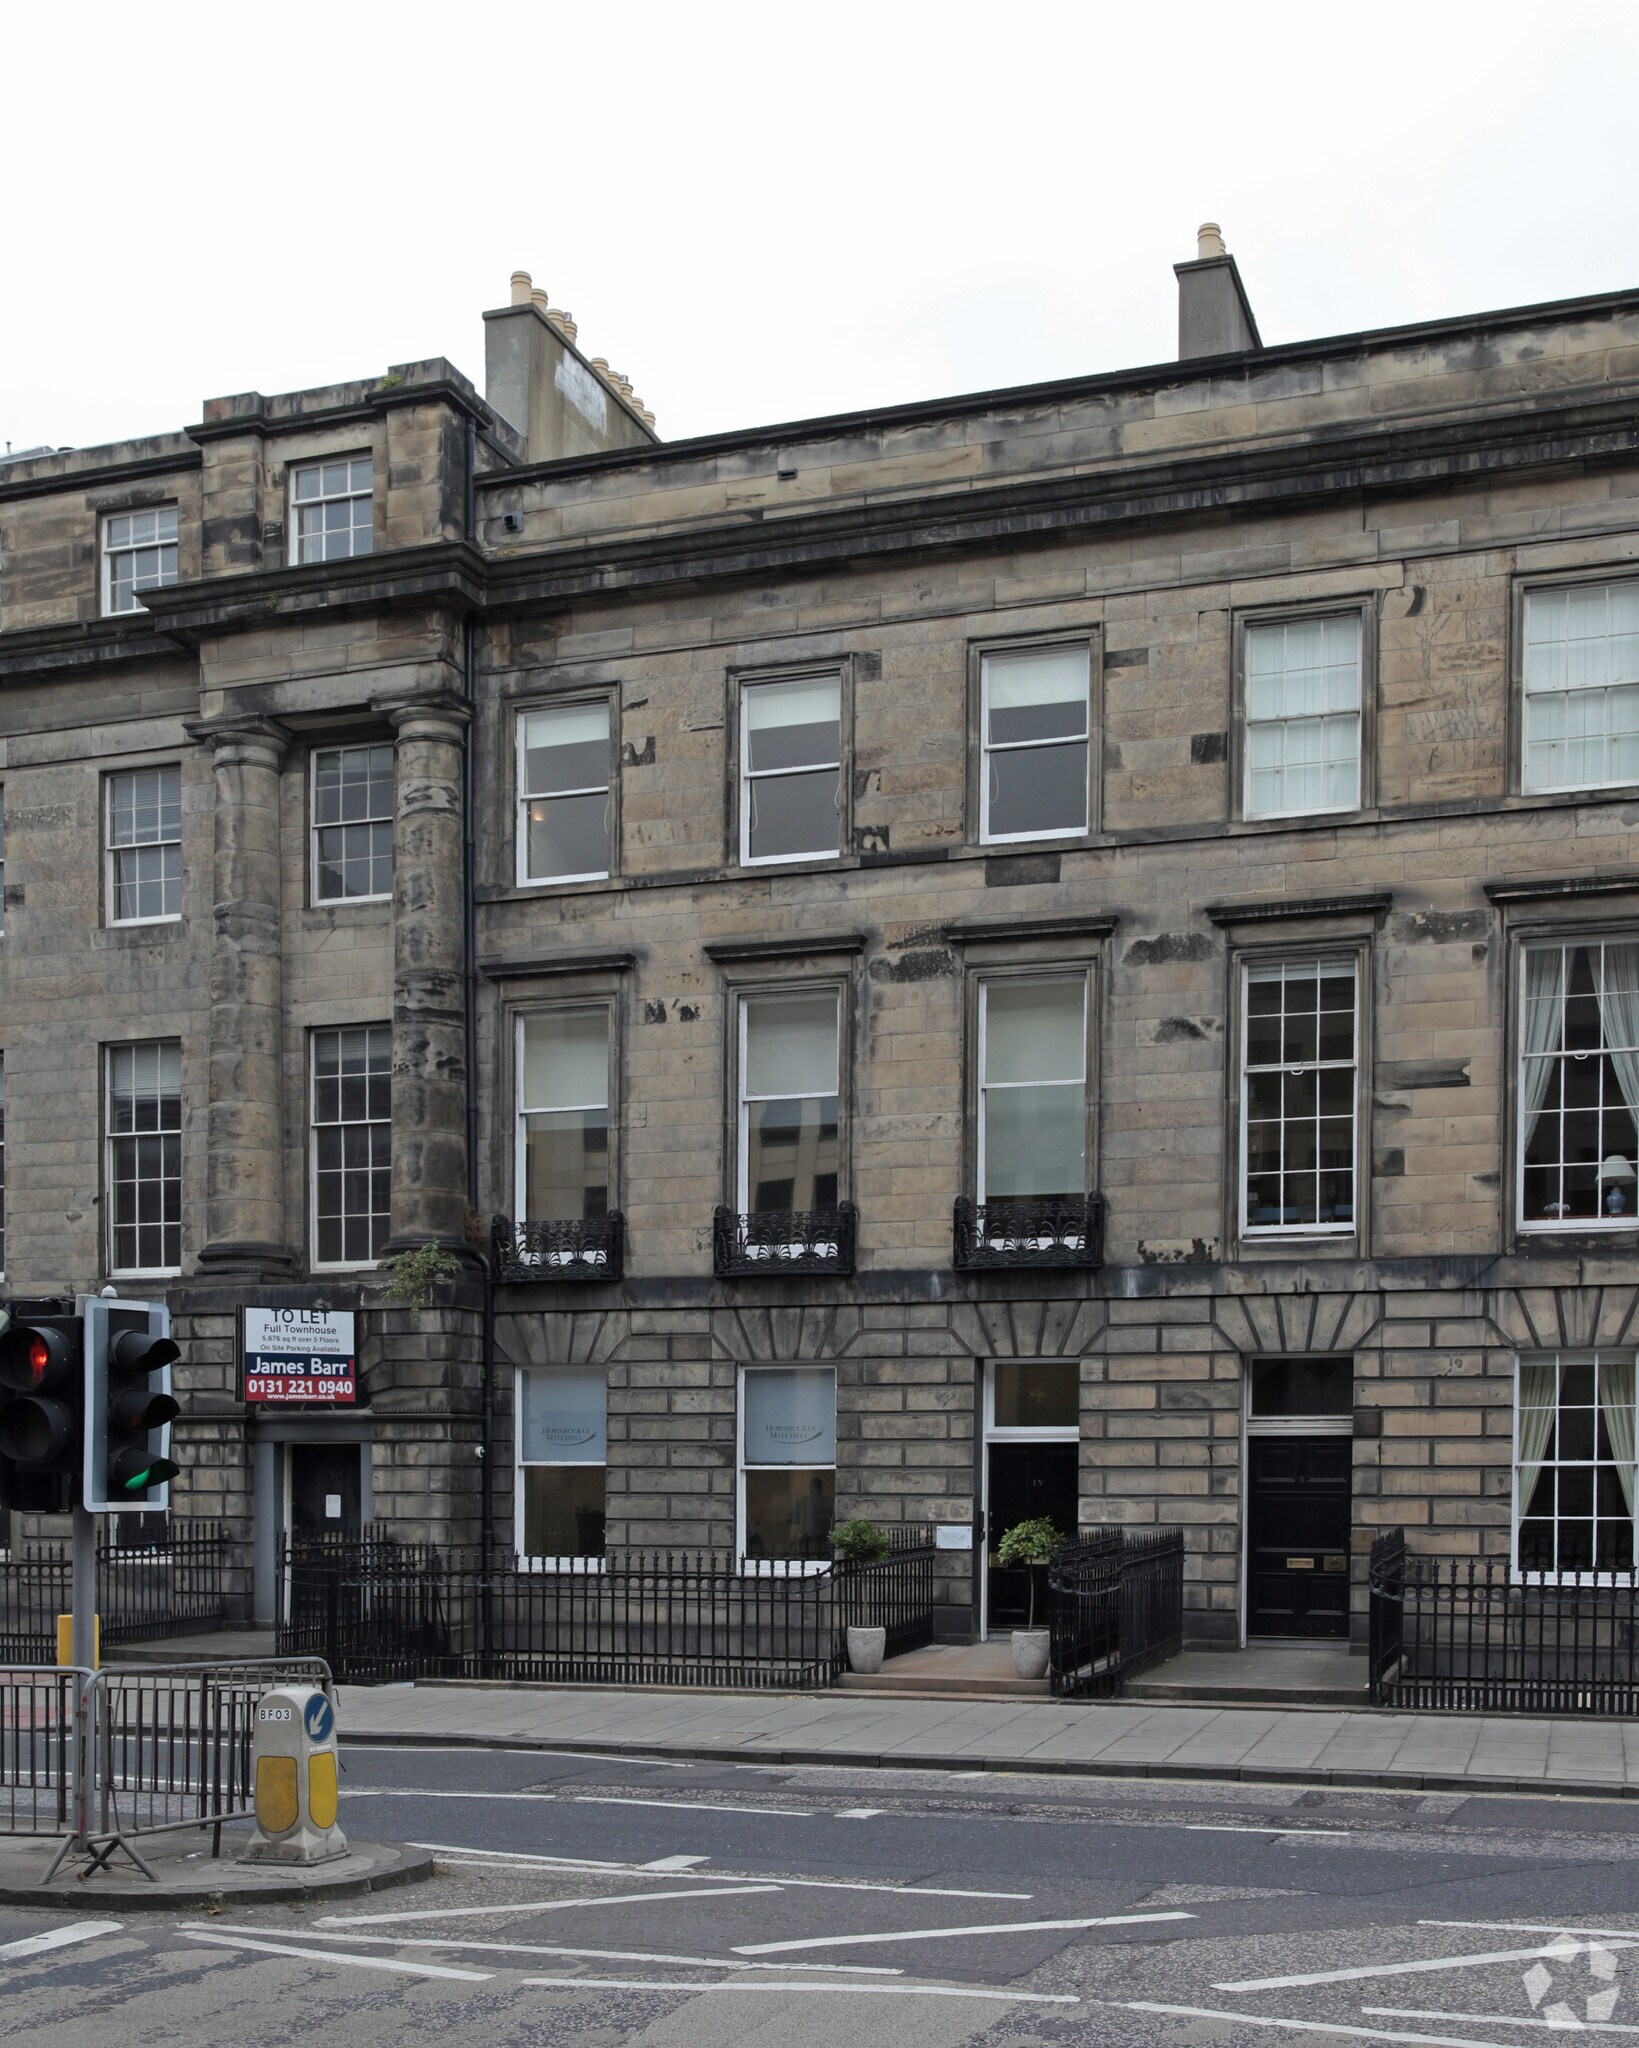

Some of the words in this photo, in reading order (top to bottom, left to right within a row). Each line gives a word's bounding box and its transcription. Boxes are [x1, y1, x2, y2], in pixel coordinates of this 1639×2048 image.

[271, 1309, 294, 1323] TO
[301, 1309, 330, 1324] LET
[264, 1324, 281, 1333] Full
[284, 1325, 337, 1335] Townhouse
[286, 1345, 311, 1353] Parking
[250, 1356, 305, 1375] James
[311, 1358, 347, 1375] Barr
[248, 1379, 283, 1393] 0131
[288, 1380, 313, 1393] 221
[318, 1380, 353, 1394] 0940
[542, 1426, 591, 1434] HORNBUCKLE
[765, 1424, 816, 1432] HORNBUCKLE
[1033, 1479, 1044, 1487] IV
